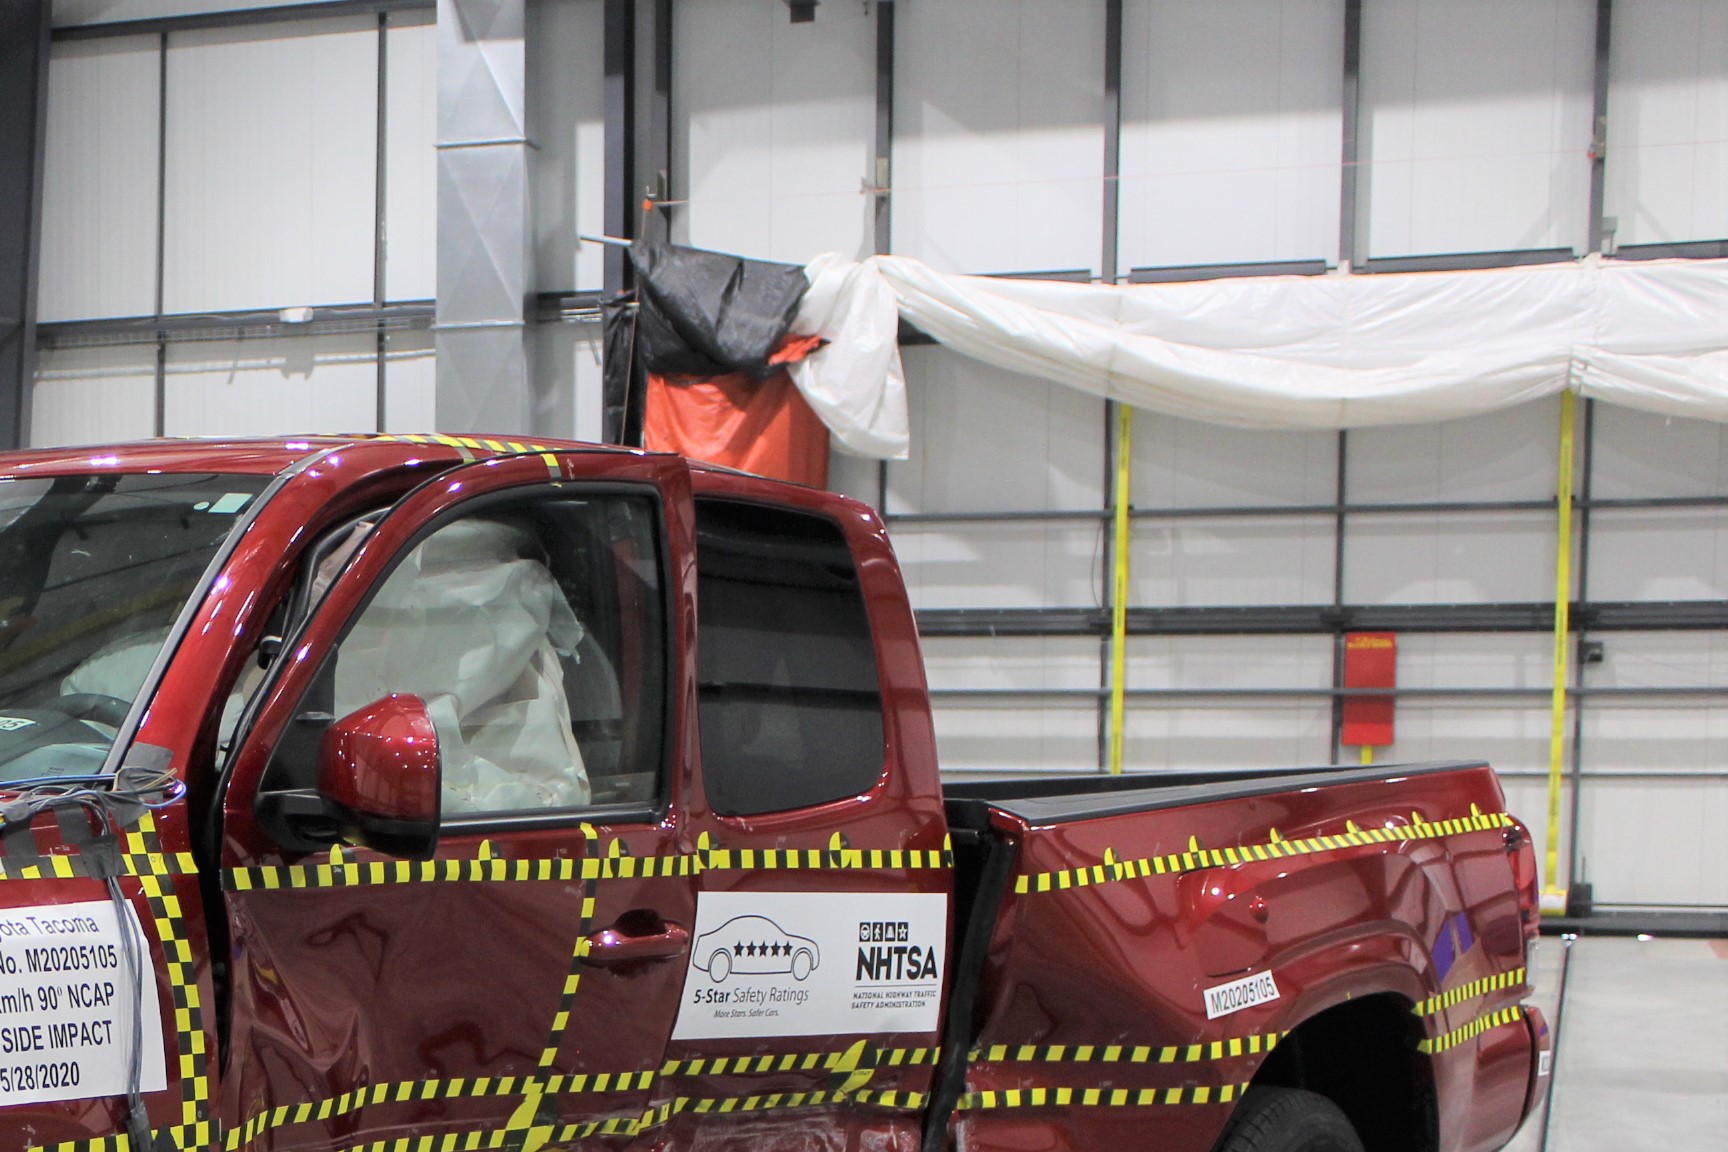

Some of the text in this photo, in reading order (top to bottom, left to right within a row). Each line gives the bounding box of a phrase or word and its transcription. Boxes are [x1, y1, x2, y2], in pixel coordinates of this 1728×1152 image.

[26, 914, 100, 936] Tacoma
[25, 944, 118, 973] M20205105
[856, 945, 938, 981] NHTSA
[67, 982, 115, 1009] NCAP
[693, 987, 809, 1006] 5-Star Safety Ratings
[851, 1000, 926, 1009] SAFETY ADMINISTRATION
[914, 990, 937, 998] TRAFFIC
[1210, 977, 1275, 1014] M20205105
[713, 1009, 731, 1018] More
[748, 1009, 765, 1017] Safer
[1, 1025, 44, 1054] SIDE
[47, 1020, 112, 1049] IMPACT
[0, 1061, 80, 1092] 5/28/2020
